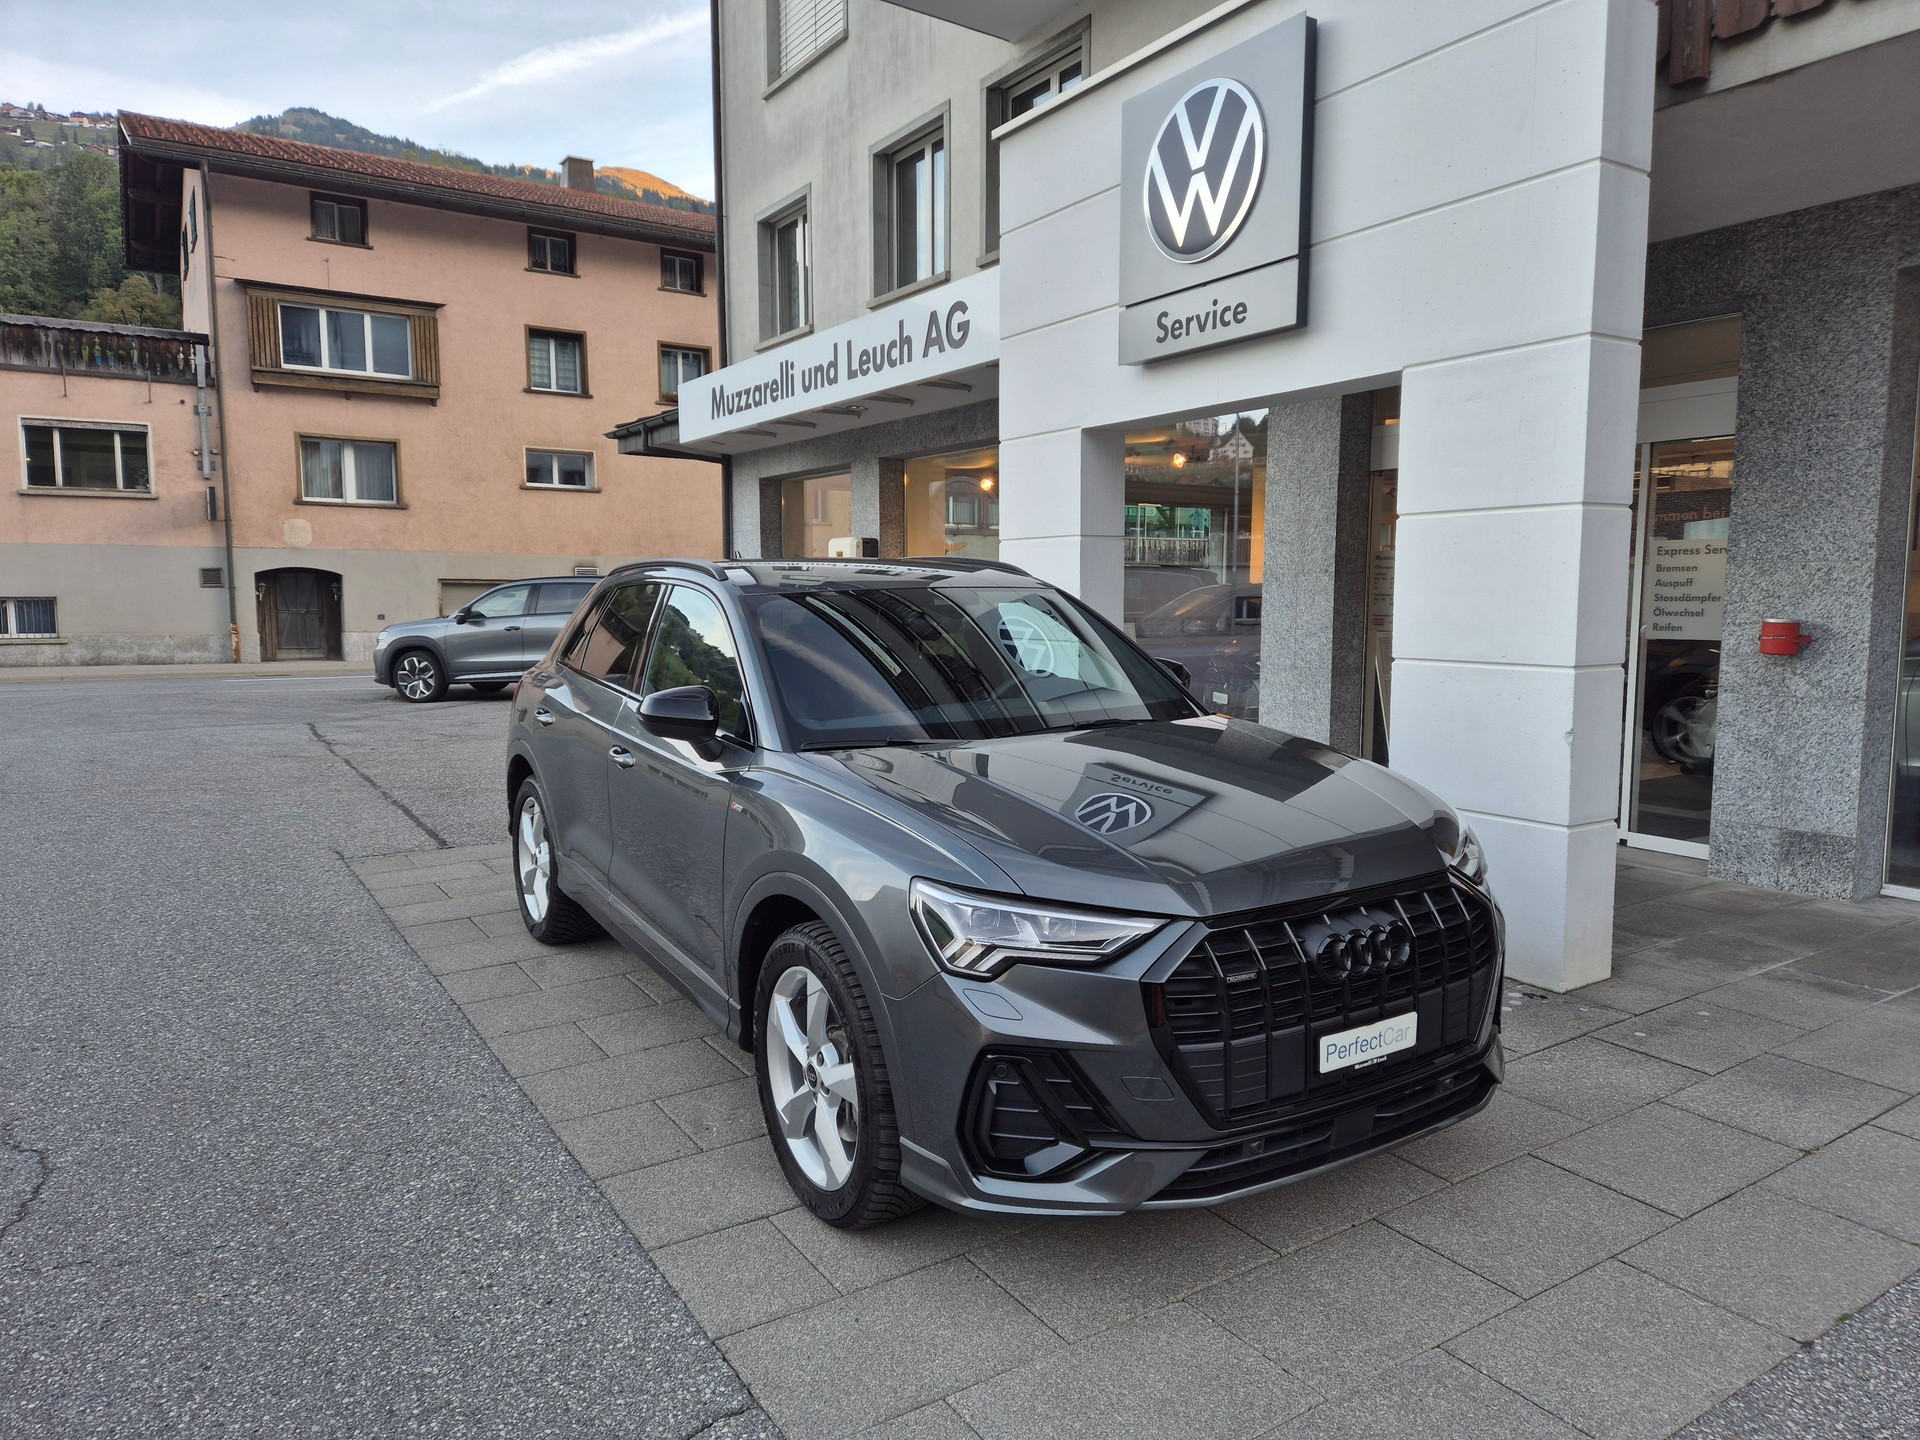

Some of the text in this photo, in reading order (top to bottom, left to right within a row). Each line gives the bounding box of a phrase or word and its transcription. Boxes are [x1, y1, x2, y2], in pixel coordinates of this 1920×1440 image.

[1156, 299, 1248, 343] Service
[711, 300, 971, 419] Muzzarelli und Leuch AG
[1703, 506, 1725, 519] bei
[1656, 546, 1701, 558] Express
[1656, 563, 1698, 572] Bremsen
[1655, 578, 1694, 588] Auspuff
[1654, 593, 1722, 603] Stossdämpfer
[1653, 606, 1704, 617] Ölwechsel
[1652, 623, 1683, 632] Reifen
[1326, 1026, 1410, 1063] PerfectCar
